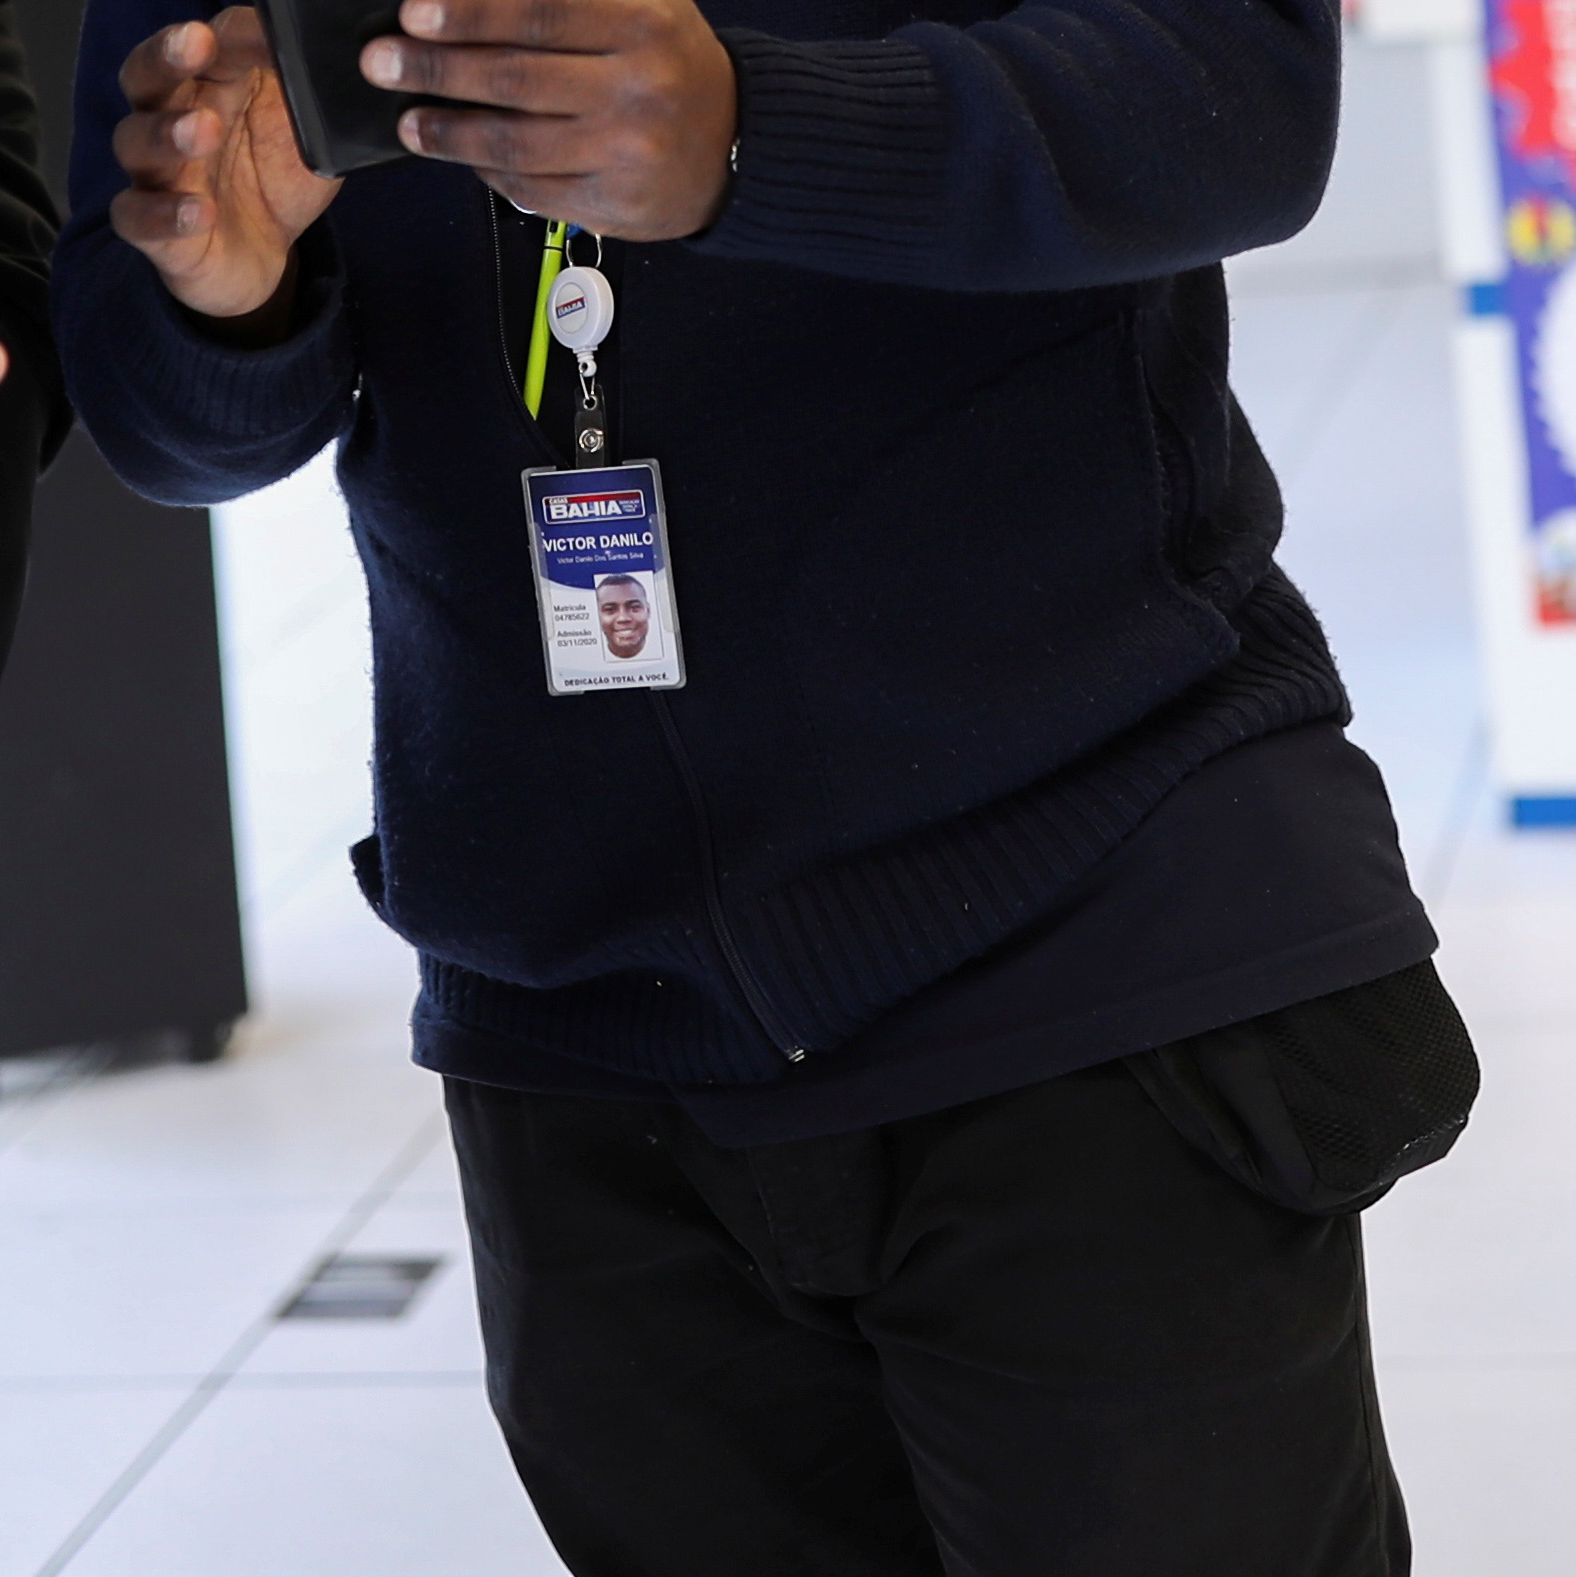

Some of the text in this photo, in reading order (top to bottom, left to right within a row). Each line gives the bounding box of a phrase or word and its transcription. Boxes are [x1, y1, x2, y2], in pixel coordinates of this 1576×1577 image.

[550, 500, 623, 520] BAHIA
[543, 531, 654, 552] VICTOR DANILO
